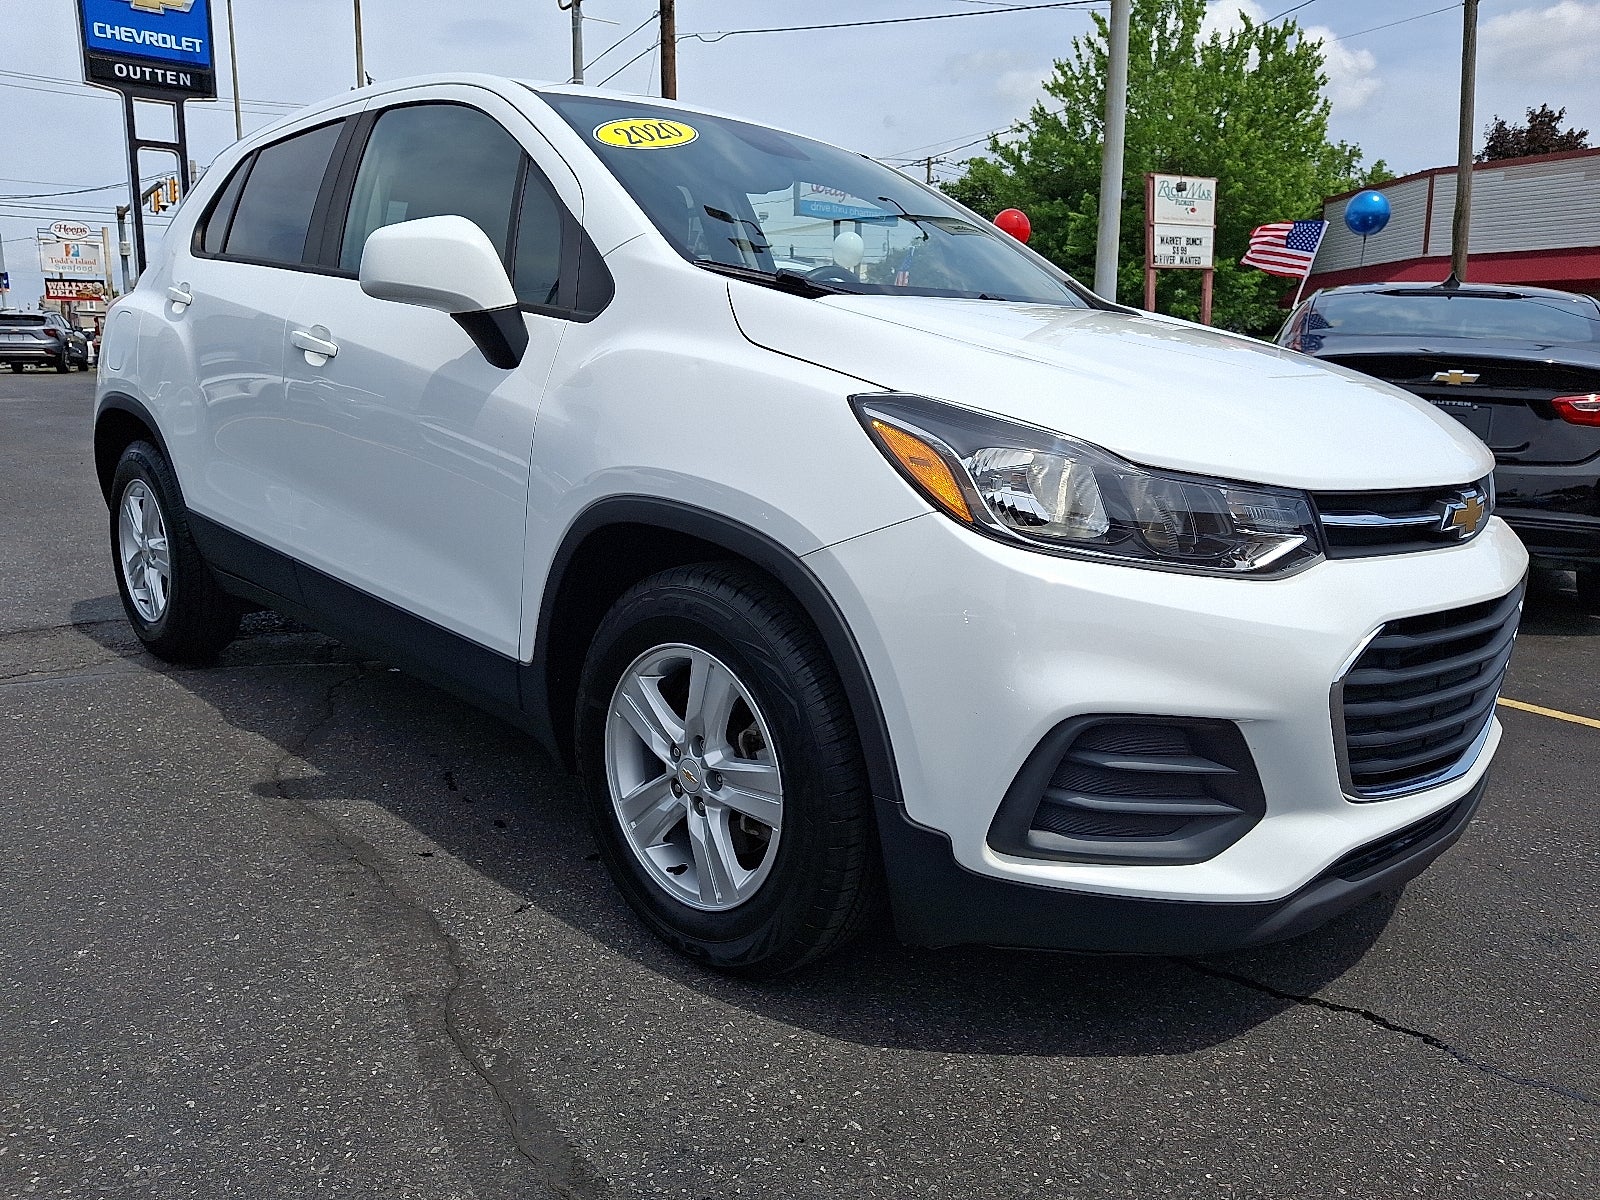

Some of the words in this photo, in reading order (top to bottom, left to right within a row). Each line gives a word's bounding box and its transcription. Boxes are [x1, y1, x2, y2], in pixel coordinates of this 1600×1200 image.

[93, 21, 203, 53] CHEVROLET
[114, 63, 191, 87] OUTTEN
[613, 122, 683, 145] 2020
[810, 202, 831, 212] drive
[832, 205, 848, 214] thru
[1160, 236, 1181, 245] MARKET
[1180, 256, 1201, 265] WANTED
[55, 264, 93, 272] Seafood
[46, 281, 92, 290] WALLY'S
[49, 289, 77, 297] DELI
[1430, 399, 1472, 407] OUTTEN
